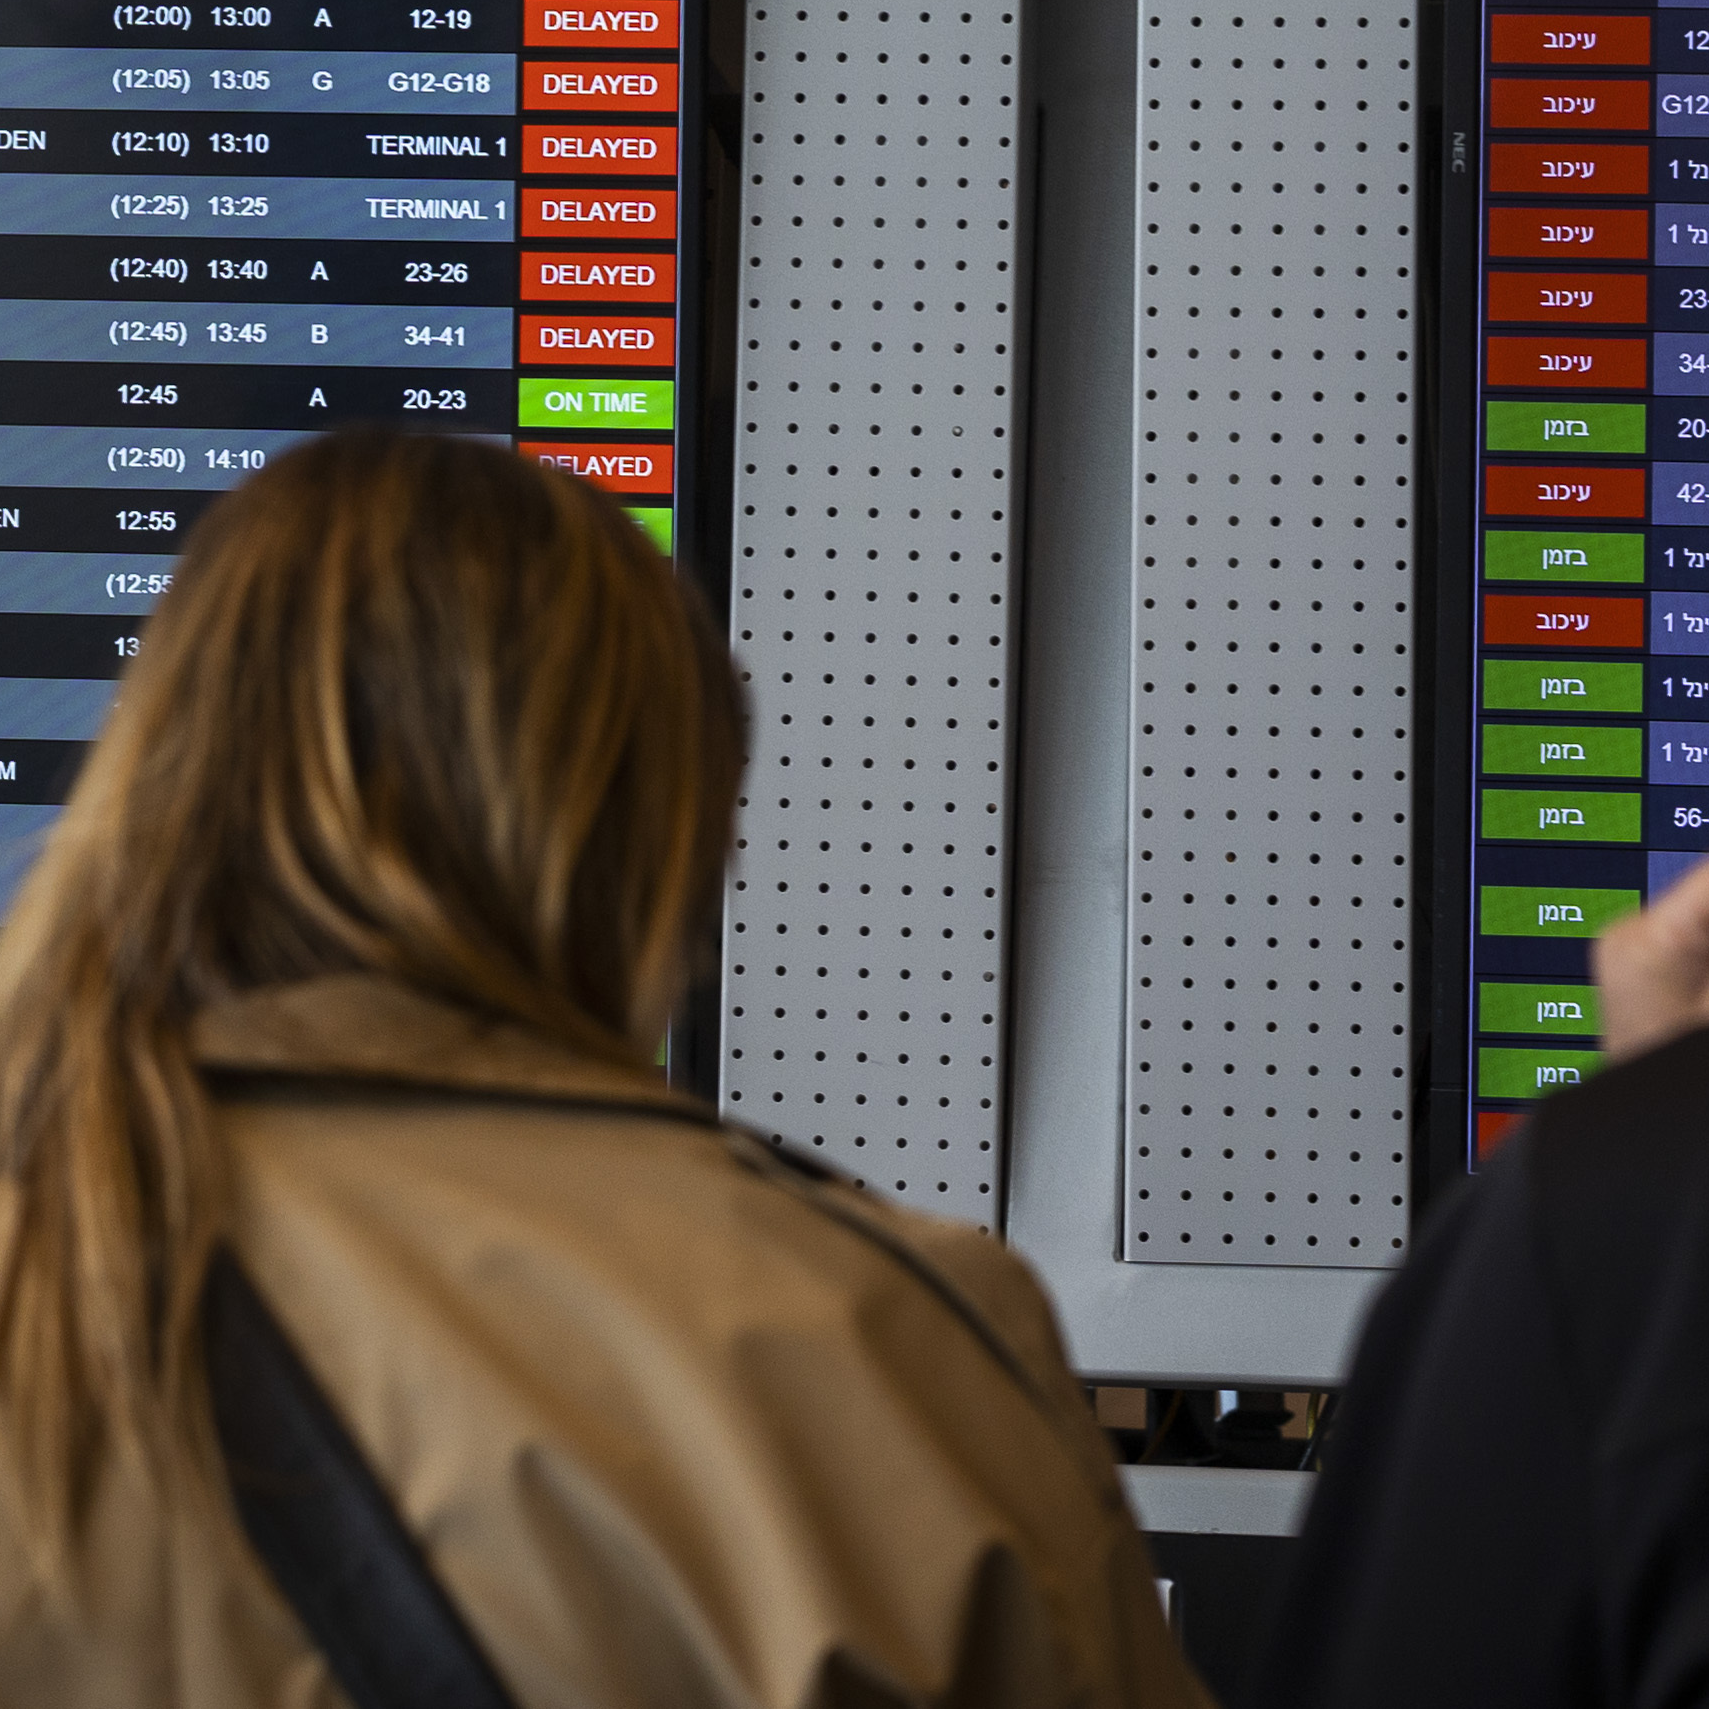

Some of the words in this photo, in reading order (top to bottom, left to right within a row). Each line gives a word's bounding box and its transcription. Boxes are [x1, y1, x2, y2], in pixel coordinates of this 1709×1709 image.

[112, 4, 192, 32] (12:00)
[210, 5, 272, 28] 13:00
[313, 7, 333, 28] A
[408, 8, 472, 30] 12-19
[543, 8, 660, 33] DELAYED
[1542, 31, 1597, 50] עיכוב
[111, 130, 190, 158] (12:10)
[208, 132, 270, 154] 13:10
[365, 134, 490, 157] TERMINAL
[494, 136, 507, 158] 1
[542, 127, 658, 159] DELAYED
[1452, 131, 1466, 174] NEC
[117, 383, 179, 405] 12:45
[308, 387, 328, 408] A
[402, 388, 467, 411] 20-23
[545, 391, 583, 412] ON
[588, 392, 647, 413] TIME
[1543, 418, 1590, 439] בזמן
[115, 510, 177, 532] 12:55
[1539, 740, 1585, 763] בזמן
[1661, 741, 1672, 763] 1
[1538, 805, 1585, 827] בזמן
